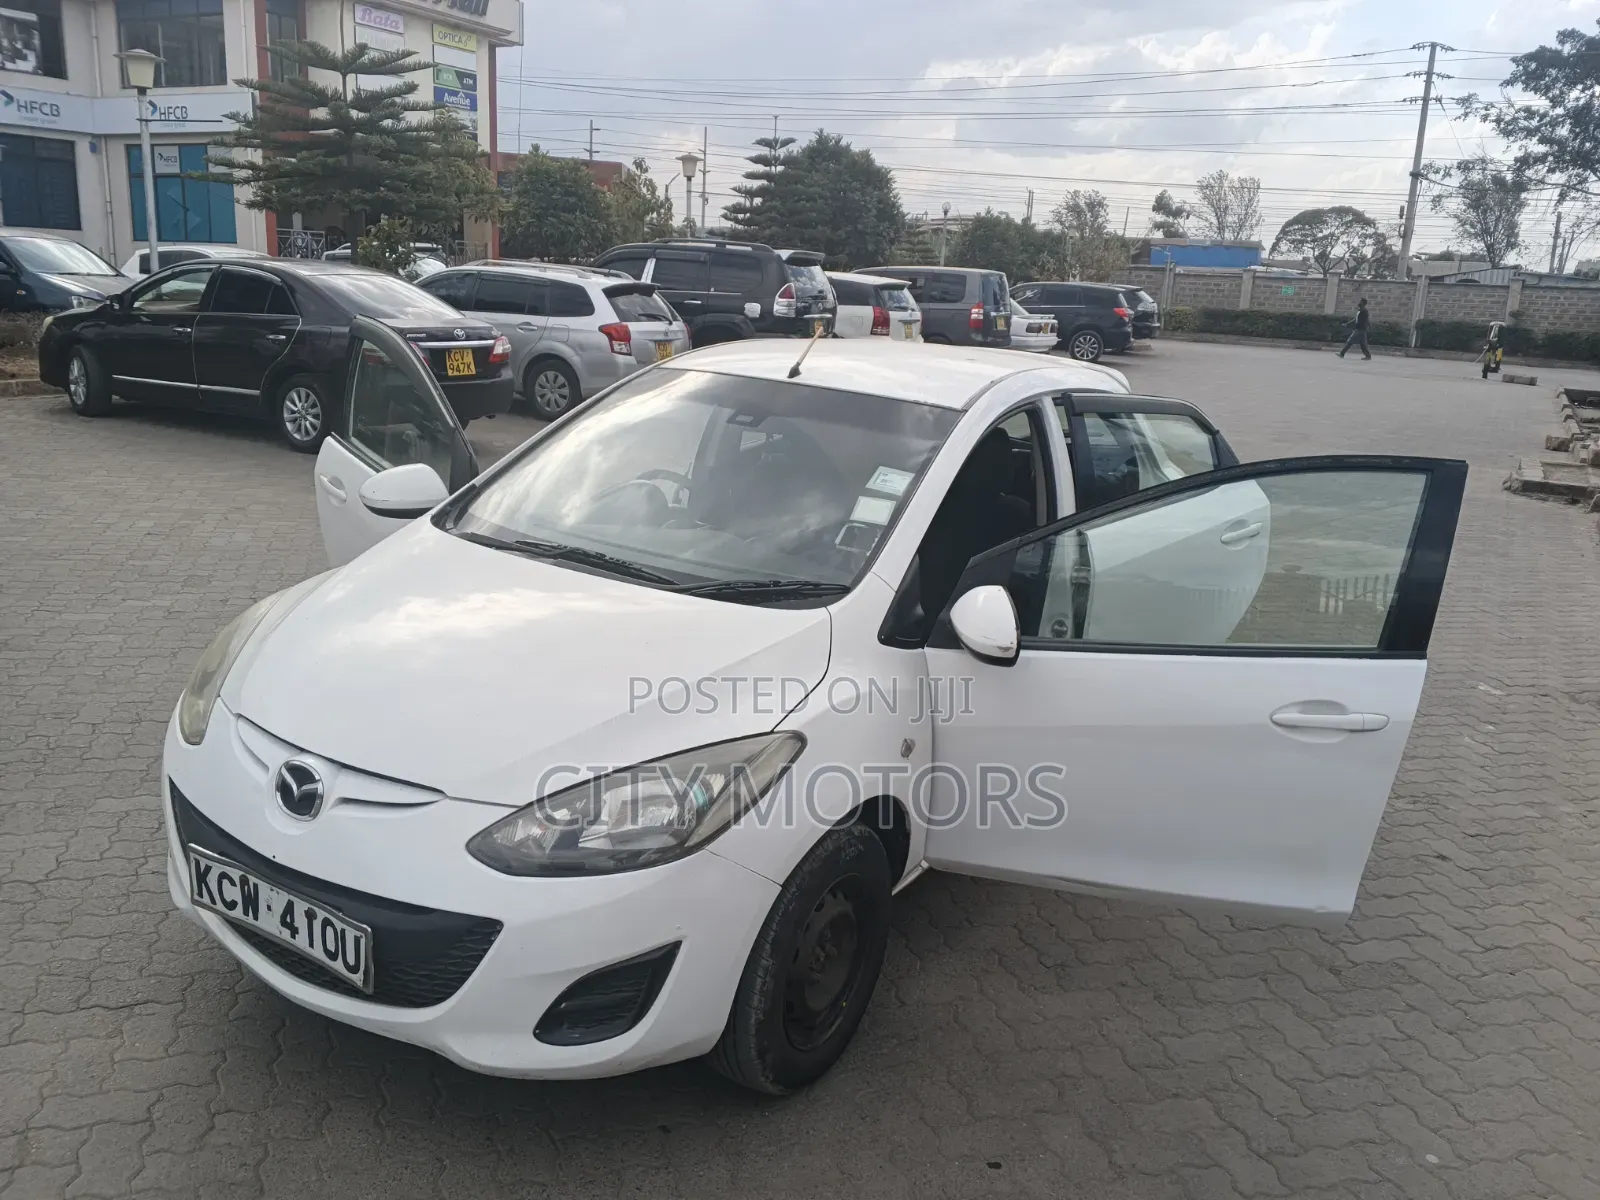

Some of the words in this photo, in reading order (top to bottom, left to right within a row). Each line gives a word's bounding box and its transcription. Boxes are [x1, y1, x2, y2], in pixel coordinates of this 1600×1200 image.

[358, 6, 401, 30] Bata
[437, 30, 464, 45] OPTICA
[443, 91, 471, 106] Avenue
[16, 98, 61, 117] HFCB
[158, 105, 189, 120] HFCB
[447, 349, 466, 362] KCV
[448, 361, 474, 374] 947K
[193, 857, 260, 922] KCW
